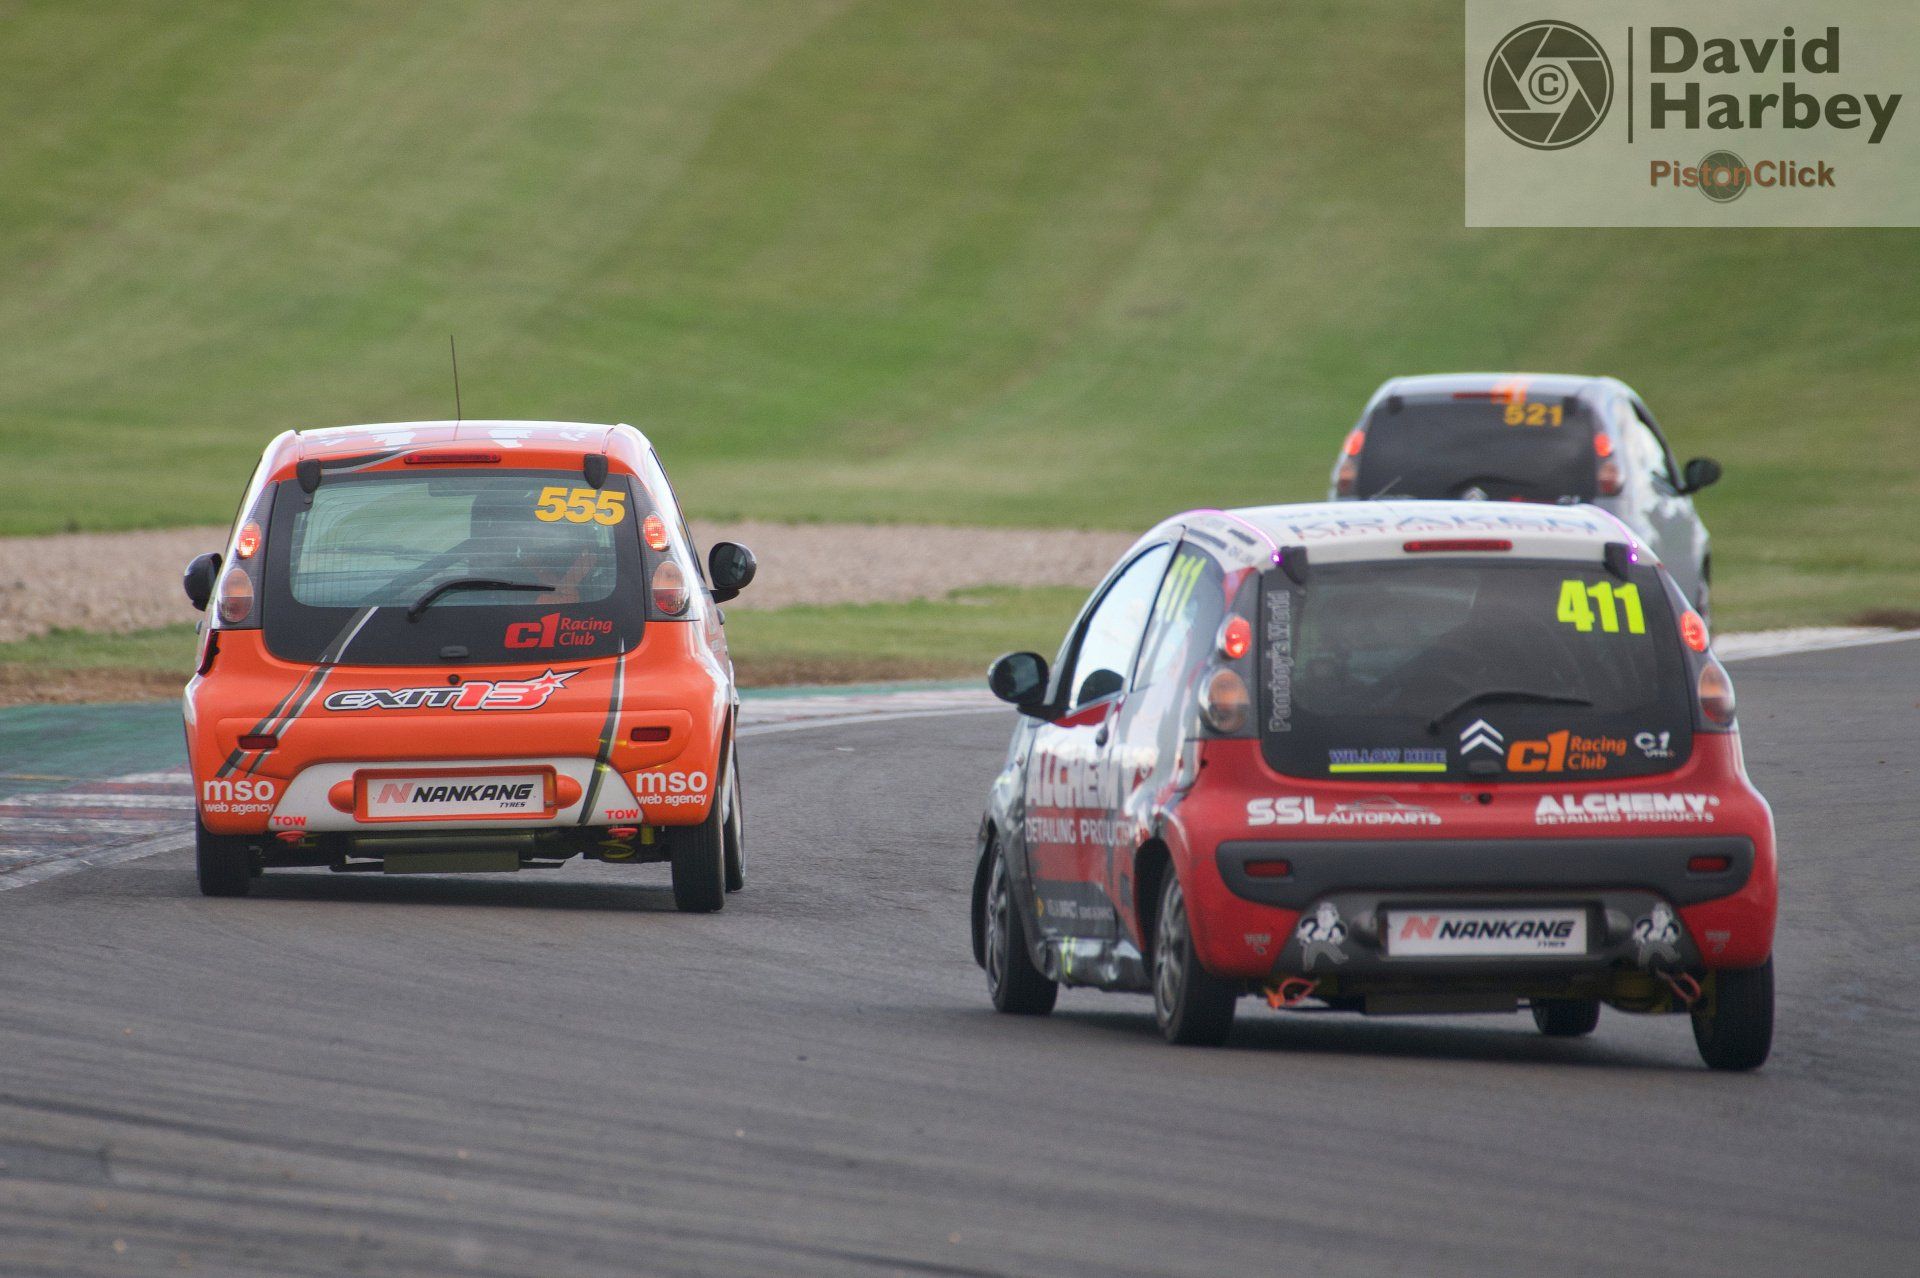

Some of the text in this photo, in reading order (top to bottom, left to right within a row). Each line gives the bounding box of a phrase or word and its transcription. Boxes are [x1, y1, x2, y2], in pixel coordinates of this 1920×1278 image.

[1504, 403, 1563, 427] 521
[534, 486, 626, 527] 555
[1557, 579, 1646, 635] 411
[560, 617, 613, 634] Racing
[559, 631, 595, 646] Club
[1569, 735, 1627, 757] Racing
[1567, 753, 1607, 770] Club
[203, 780, 275, 801] mso
[636, 771, 708, 793] mso
[412, 783, 534, 803] NANKANG
[637, 793, 707, 806] web agency
[204, 802, 275, 815] web agency
[605, 809, 639, 820] TOW
[1247, 796, 1443, 826] SSL AUTOPARTS
[1535, 811, 1715, 825] DETAILING PRODUCTS
[273, 816, 307, 826] TOW
[1438, 919, 1576, 940] NANKANG
